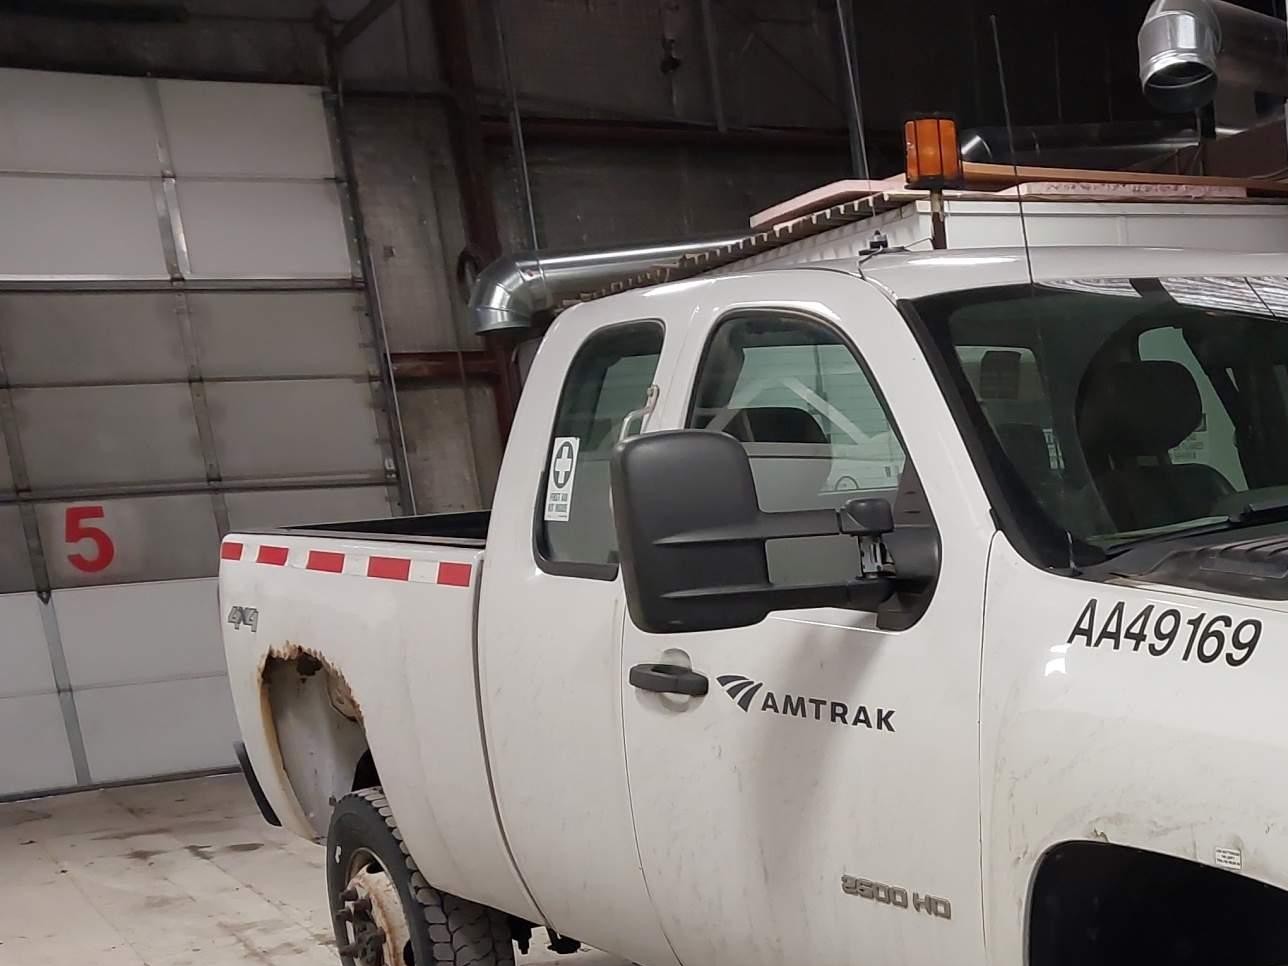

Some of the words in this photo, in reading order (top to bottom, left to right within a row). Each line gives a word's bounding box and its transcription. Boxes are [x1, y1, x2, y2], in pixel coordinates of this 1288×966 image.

[65, 505, 114, 573] 5
[1066, 598, 1263, 667] AA49169
[761, 691, 896, 732] AMTRAK
[841, 874, 908, 909] 2500
[912, 892, 951, 920] HD
